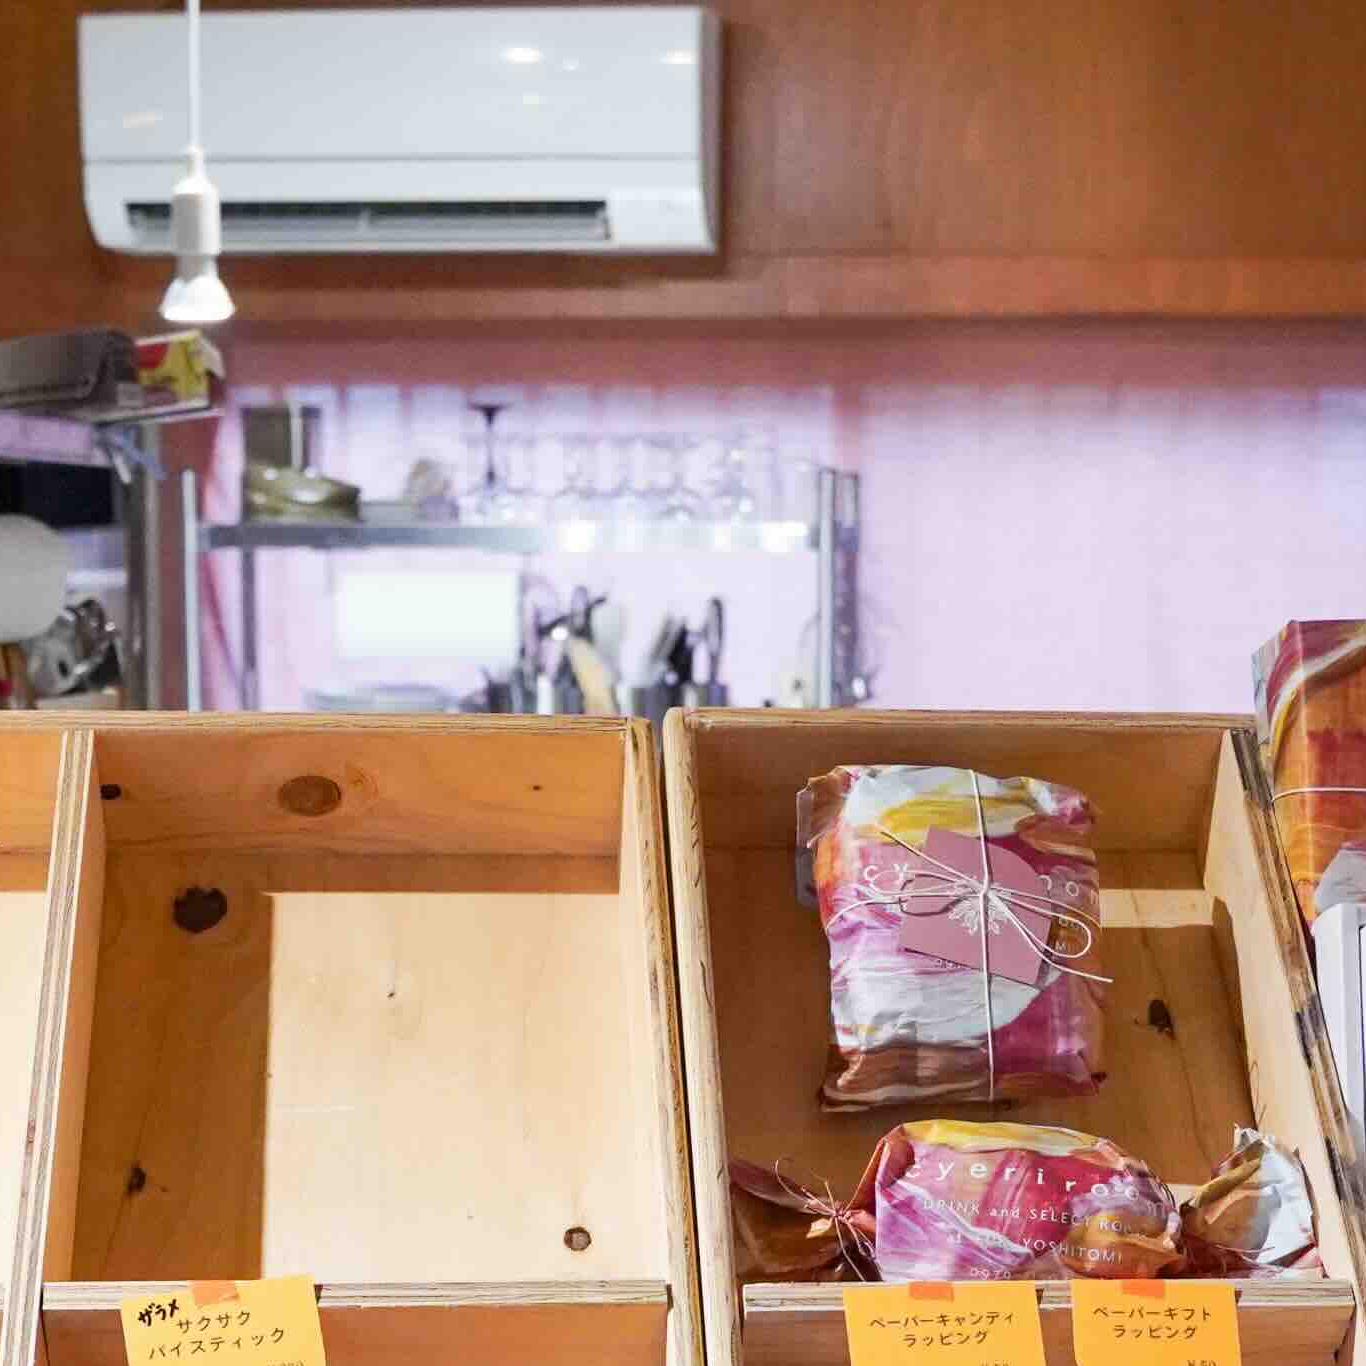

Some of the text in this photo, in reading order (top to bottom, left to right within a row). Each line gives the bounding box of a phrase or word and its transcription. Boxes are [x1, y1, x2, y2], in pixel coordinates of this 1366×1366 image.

[989, 1206, 1021, 1221] and
[1029, 1207, 1092, 1228] SELECT
[1023, 1237, 1124, 1264] YOSHITOMI
[137, 1298, 180, 1327] ザラメ
[176, 1310, 252, 1335] サクサク
